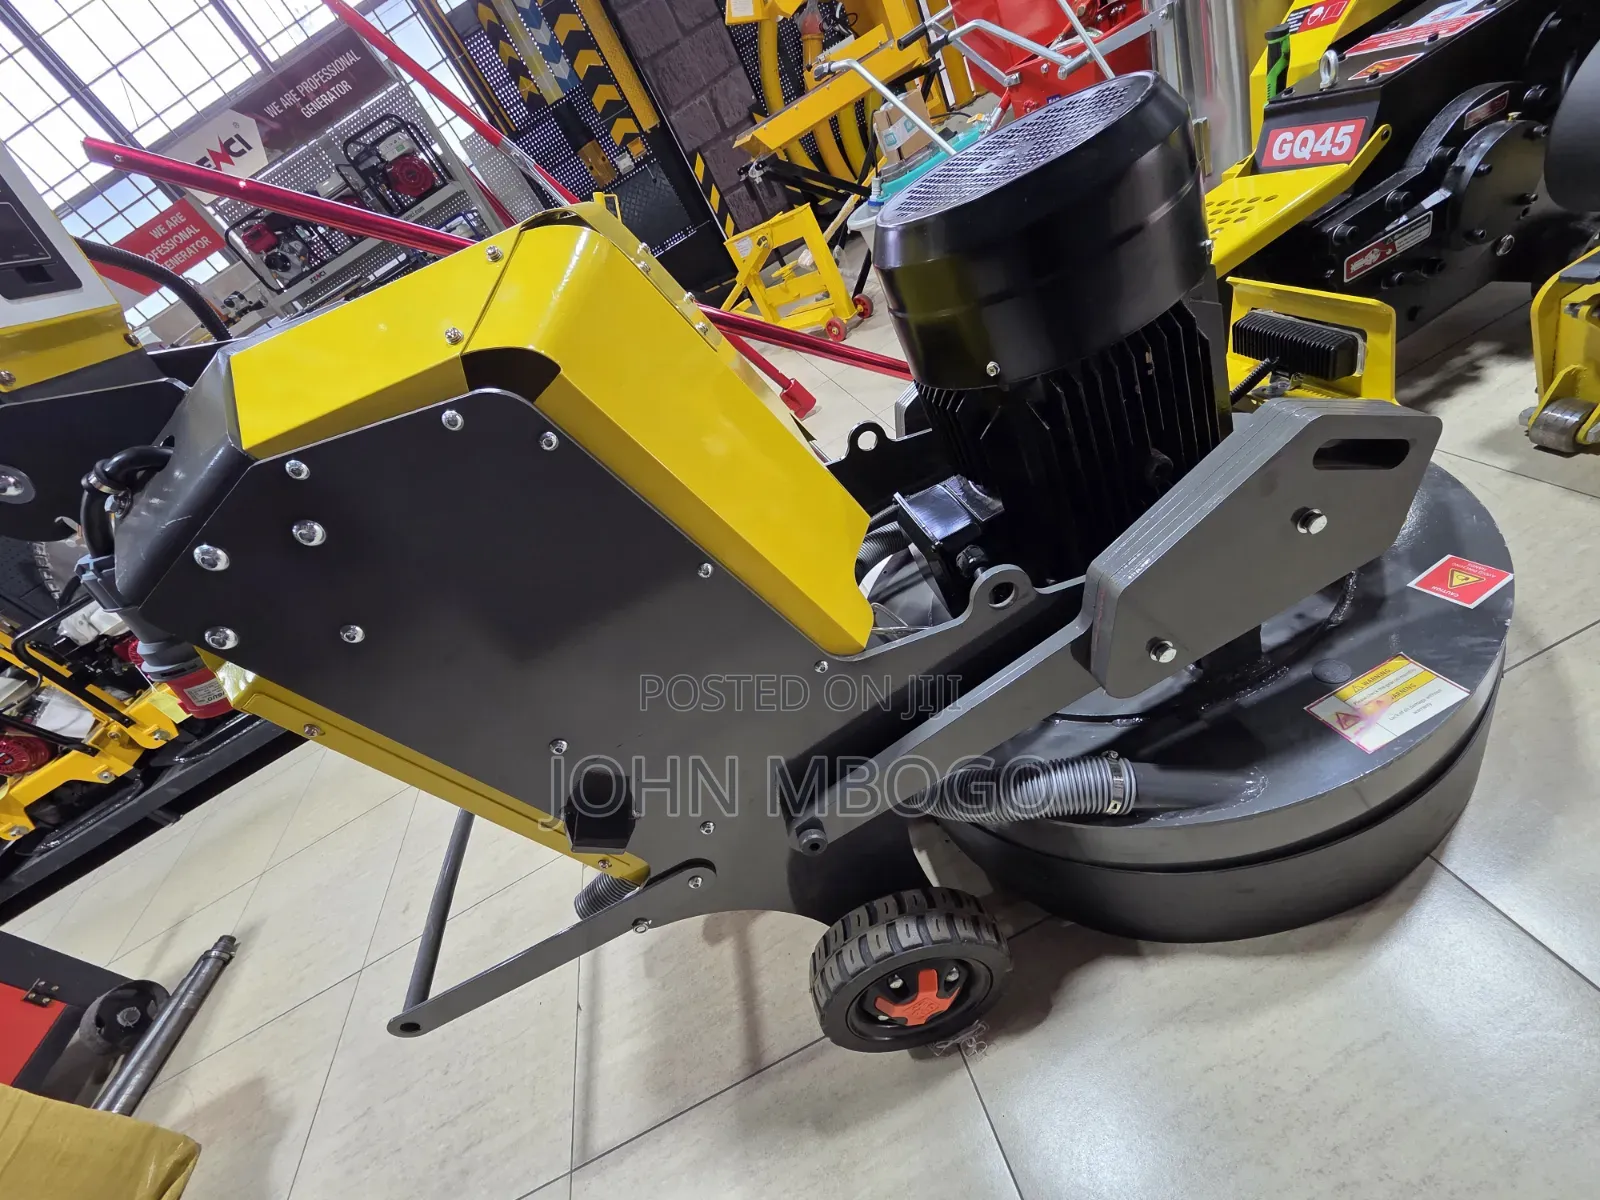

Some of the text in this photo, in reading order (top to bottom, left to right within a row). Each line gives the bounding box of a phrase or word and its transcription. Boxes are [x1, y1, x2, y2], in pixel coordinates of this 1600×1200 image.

[264, 49, 361, 118] WE ARE PROFESSIONAL
[300, 80, 353, 119] GENERATOR
[195, 132, 253, 171] ENCI
[1272, 124, 1355, 160] GQ45
[145, 224, 200, 262] OFESSIONAL
[149, 212, 186, 239] WE ARE
[1362, 668, 1391, 686] WARNING
